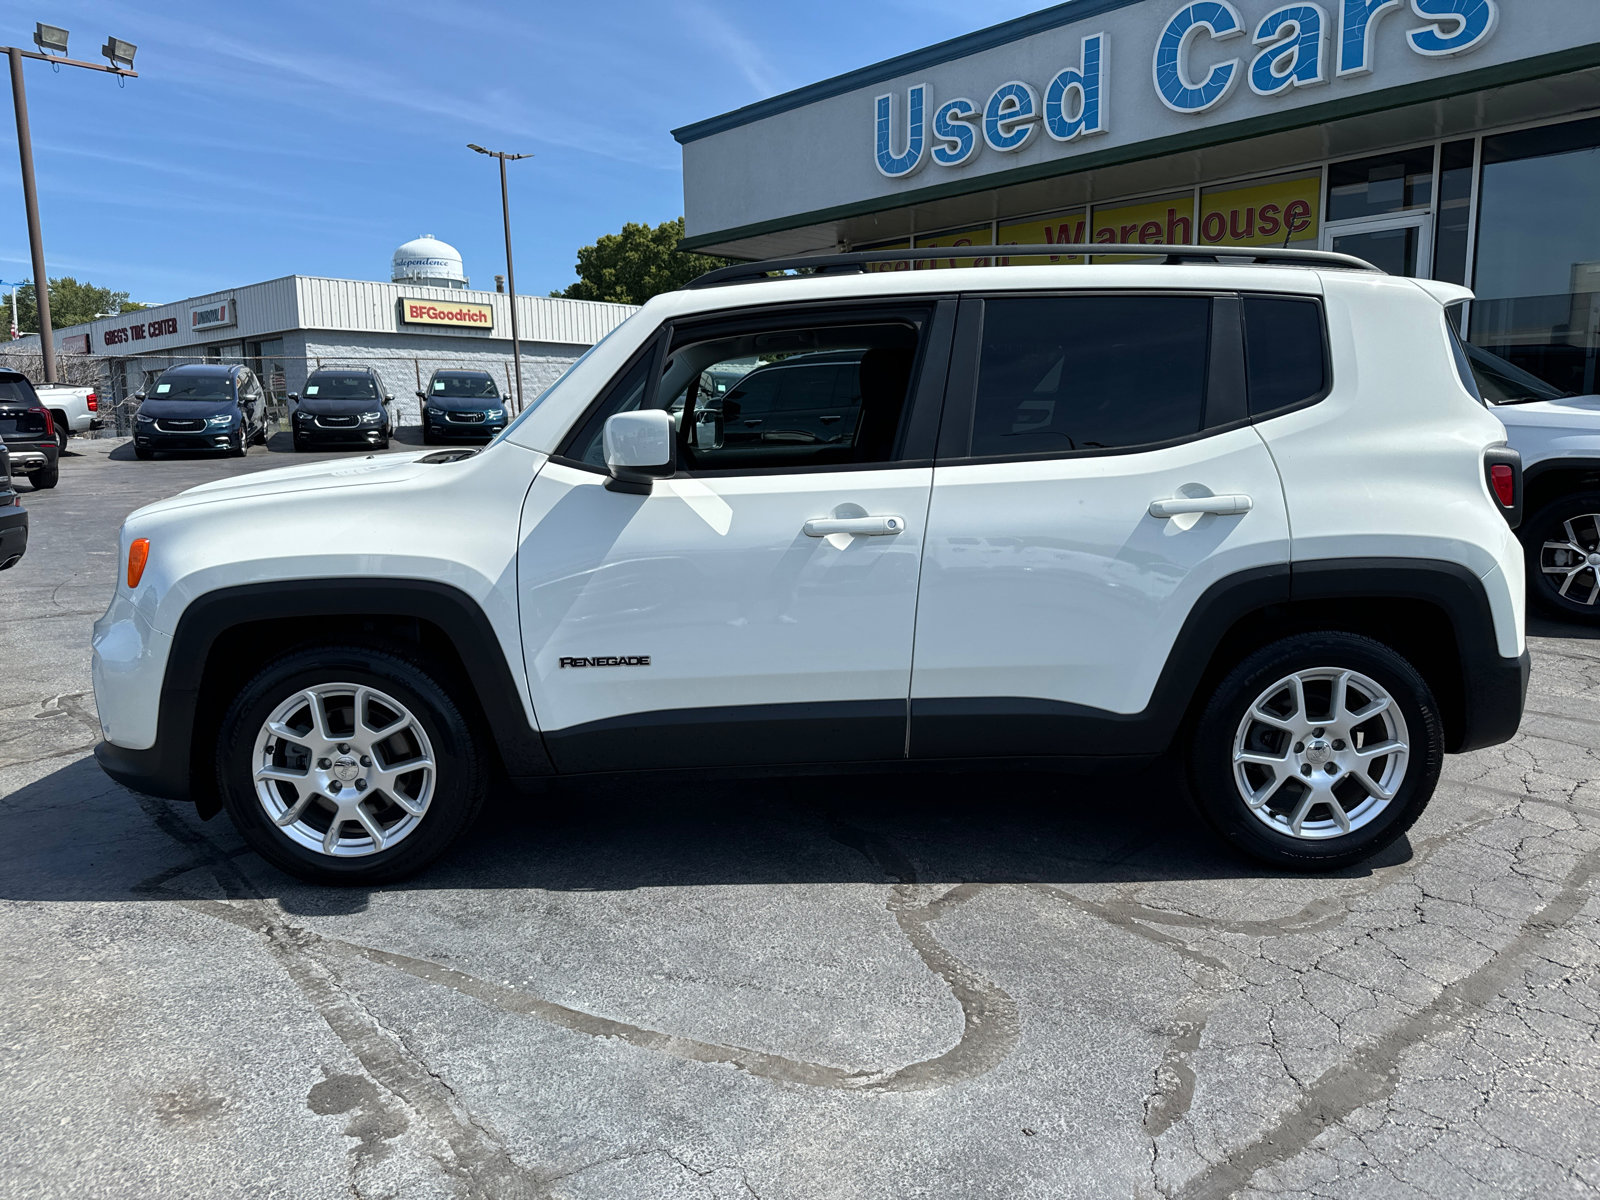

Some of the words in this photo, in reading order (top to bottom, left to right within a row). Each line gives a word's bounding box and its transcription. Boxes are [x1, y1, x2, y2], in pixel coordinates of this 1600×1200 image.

[874, 32, 1112, 179] Used
[1152, 0, 1499, 114] Cars
[1044, 199, 1312, 262] Warehouse
[409, 304, 488, 323] BFGoodrich
[104, 327, 129, 346] GREG'S
[130, 323, 147, 341] TIRE
[148, 317, 178, 339] CENTER
[559, 655, 650, 669] RENEGADE
